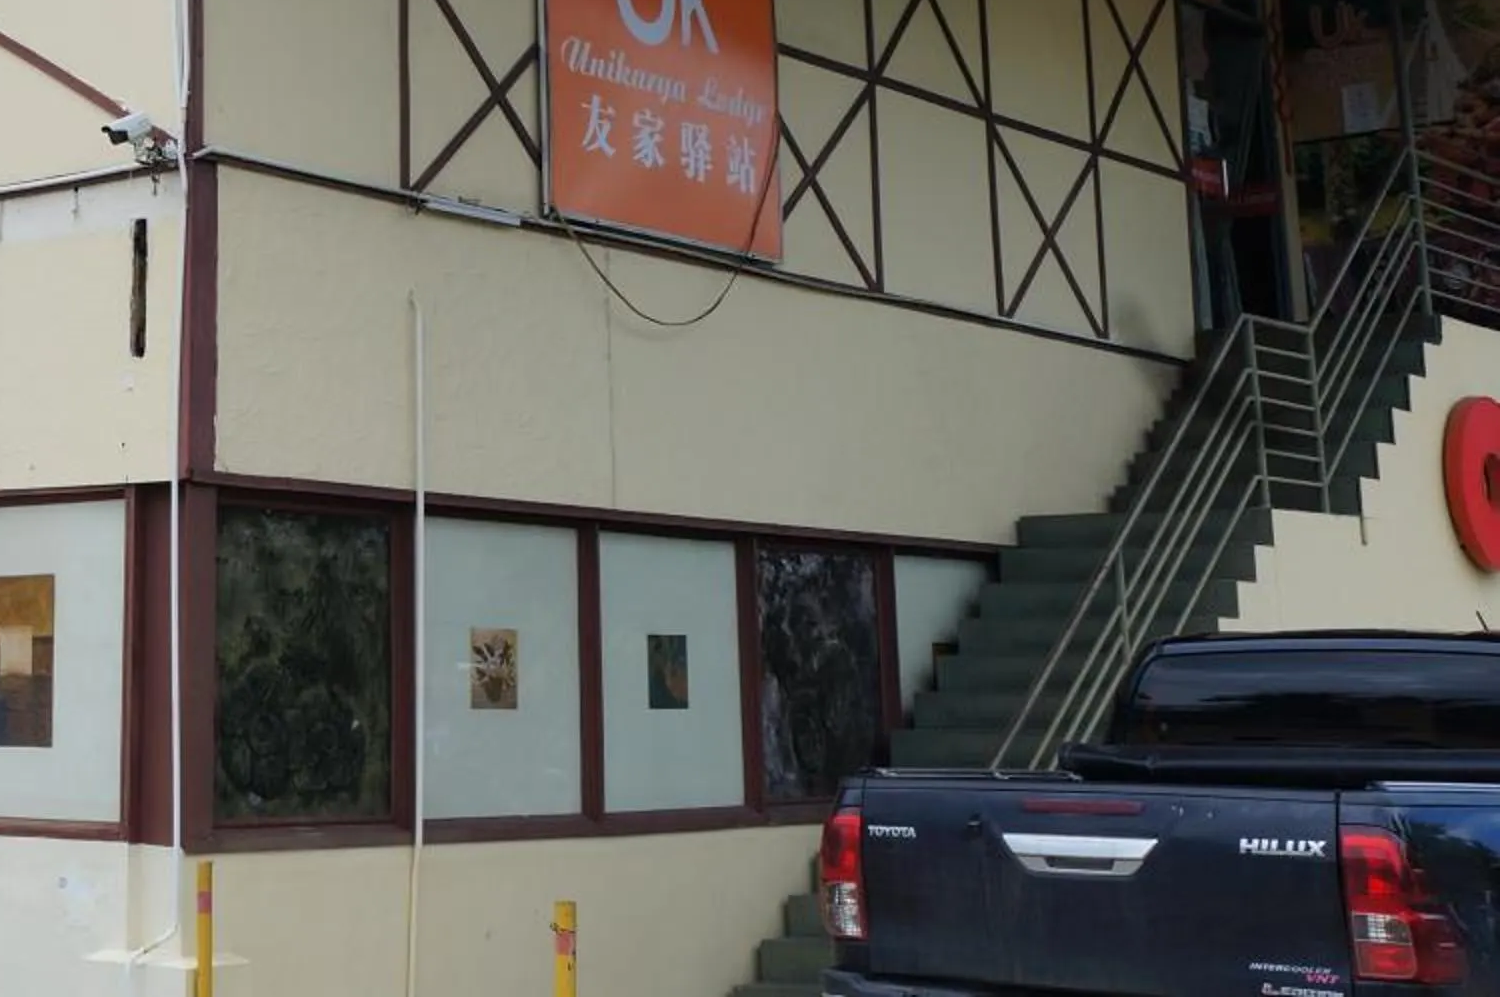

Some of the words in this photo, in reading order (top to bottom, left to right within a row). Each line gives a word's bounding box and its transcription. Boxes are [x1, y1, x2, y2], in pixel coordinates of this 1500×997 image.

[560, 35, 687, 106] Unikarya
[696, 75, 767, 127] Lodge
[867, 824, 917, 839] TOYOTA
[1239, 838, 1327, 857] HILUX
